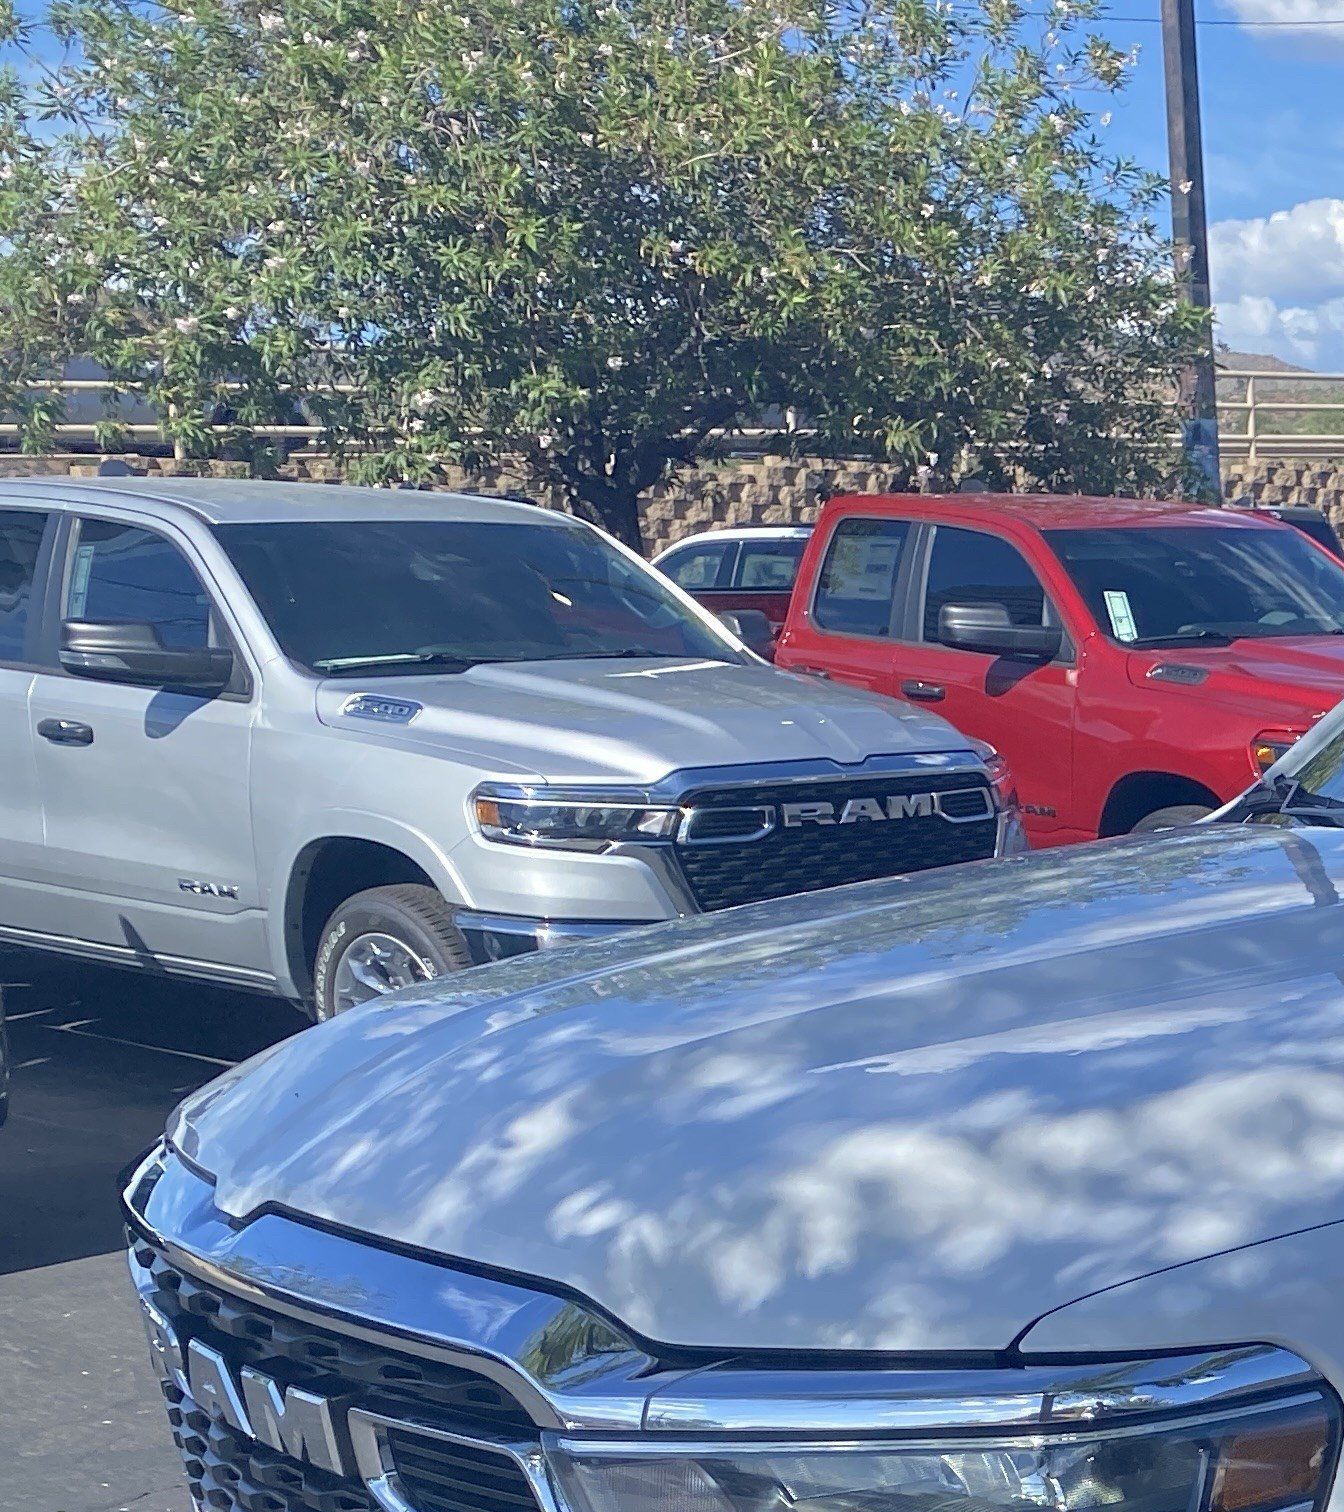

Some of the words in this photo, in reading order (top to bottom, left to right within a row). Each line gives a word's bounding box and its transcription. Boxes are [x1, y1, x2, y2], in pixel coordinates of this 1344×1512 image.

[781, 793, 932, 828] RAM
[178, 878, 240, 901] RAM
[144, 1299, 344, 1477] RAM
